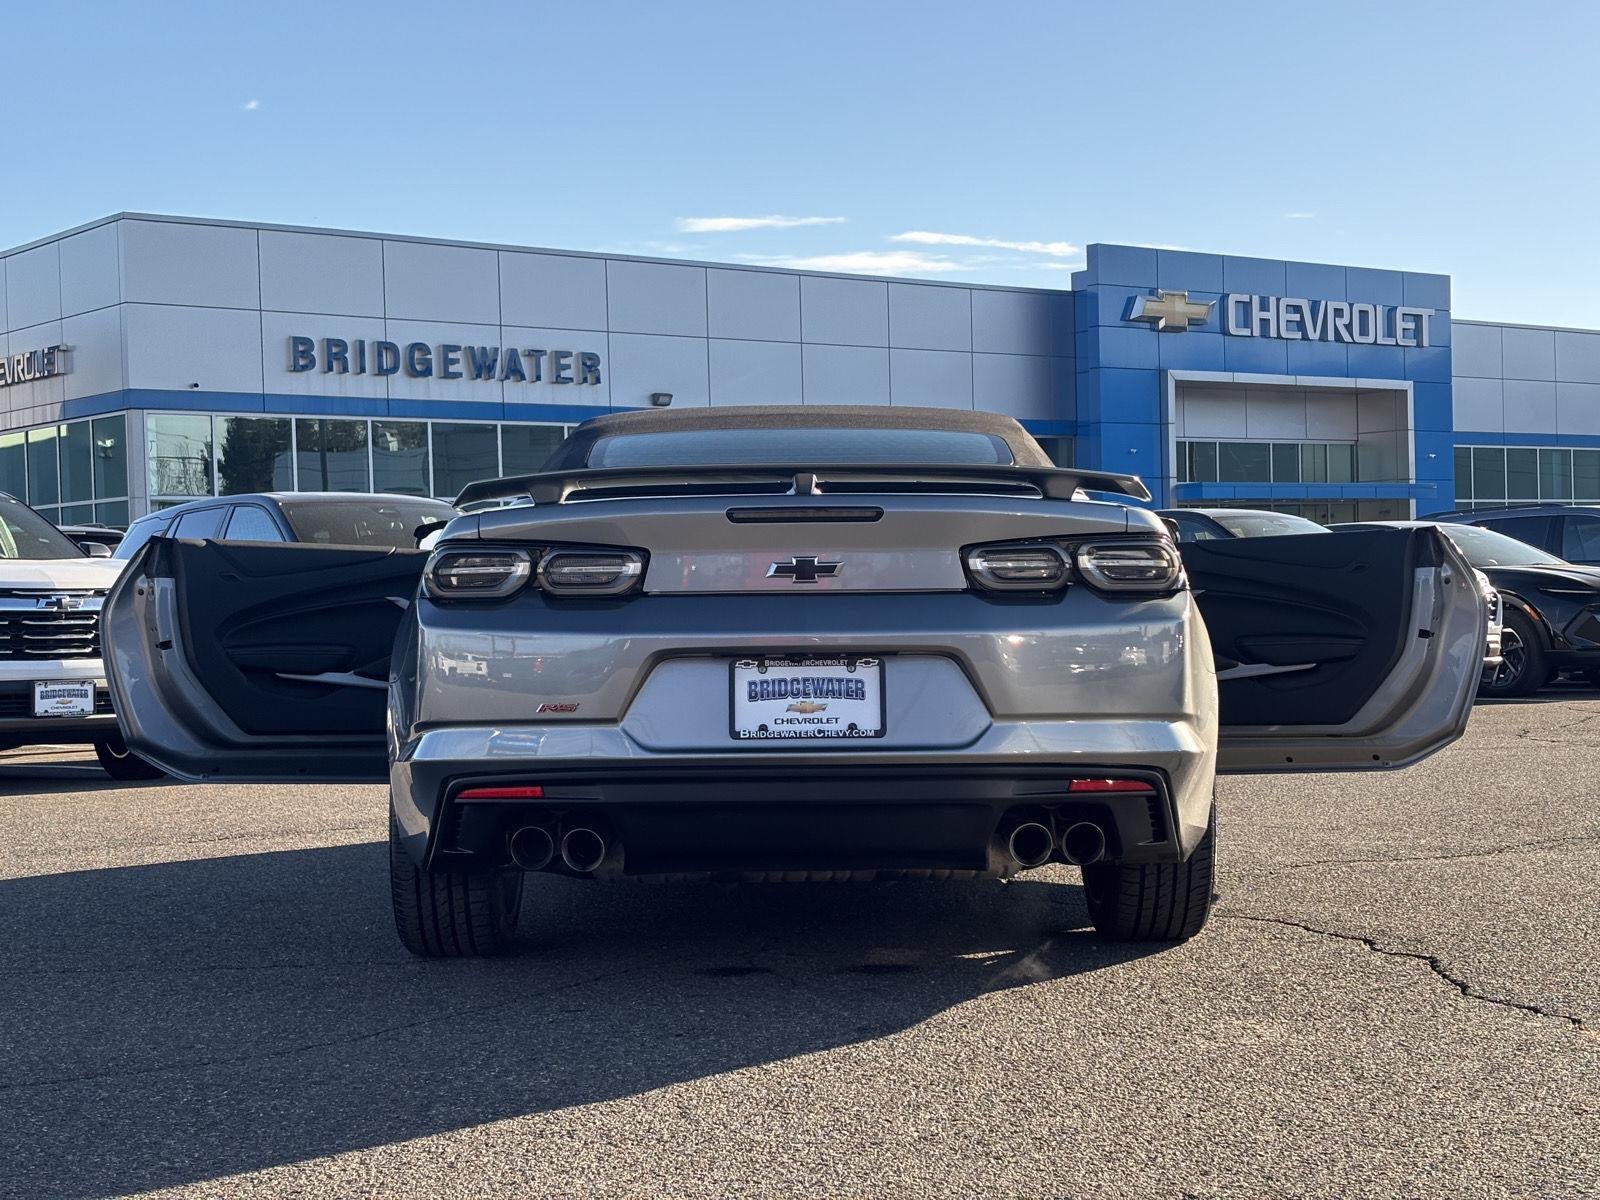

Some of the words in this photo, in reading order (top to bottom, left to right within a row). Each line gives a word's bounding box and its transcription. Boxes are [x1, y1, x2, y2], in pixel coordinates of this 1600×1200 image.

[1227, 293, 1435, 347] CHEVROLET
[287, 335, 602, 386] BRIDGEWATER
[40, 688, 89, 700] BRIDGEWATER
[747, 677, 866, 702] BRIDGEWATER
[774, 716, 840, 725] CHEVROLET
